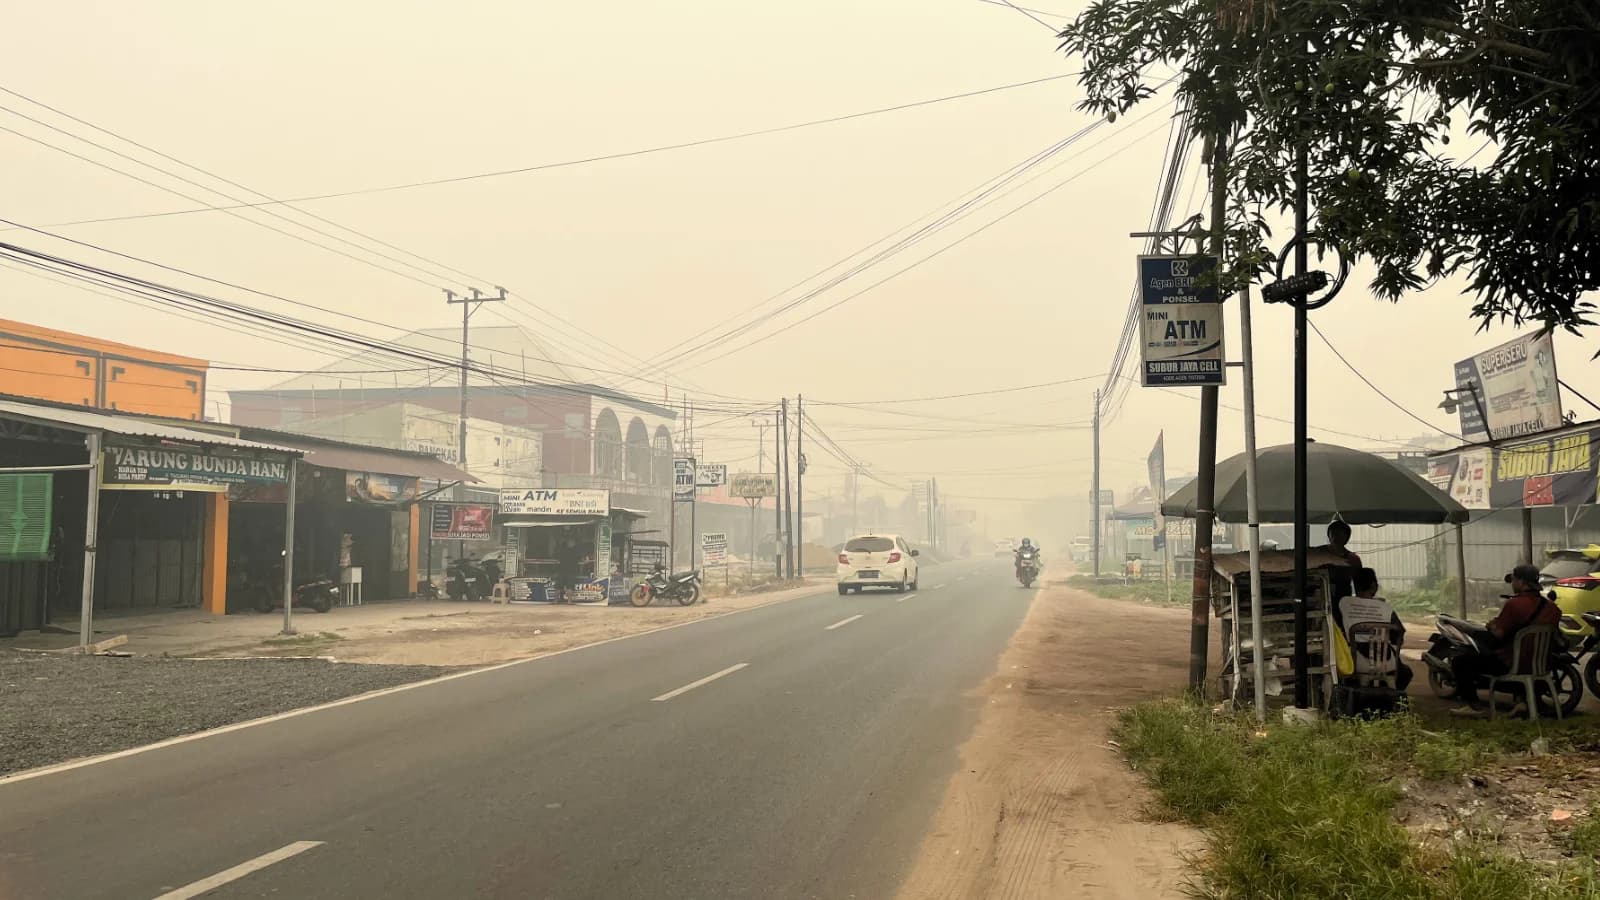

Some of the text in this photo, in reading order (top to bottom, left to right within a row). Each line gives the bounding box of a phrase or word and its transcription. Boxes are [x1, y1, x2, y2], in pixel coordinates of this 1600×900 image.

[1150, 278, 1174, 290] Agen
[1162, 295, 1200, 303] PONSEL
[1147, 312, 1168, 320] MINI
[1164, 319, 1207, 340] ATM
[1149, 360, 1218, 373] SUBUR JAYA CELL
[1497, 442, 1548, 481] SUBUR
[1551, 433, 1591, 473] JAYA
[191, 454, 247, 475] BUNDA
[675, 474, 694, 485] ATM
[523, 490, 558, 501] ATM
